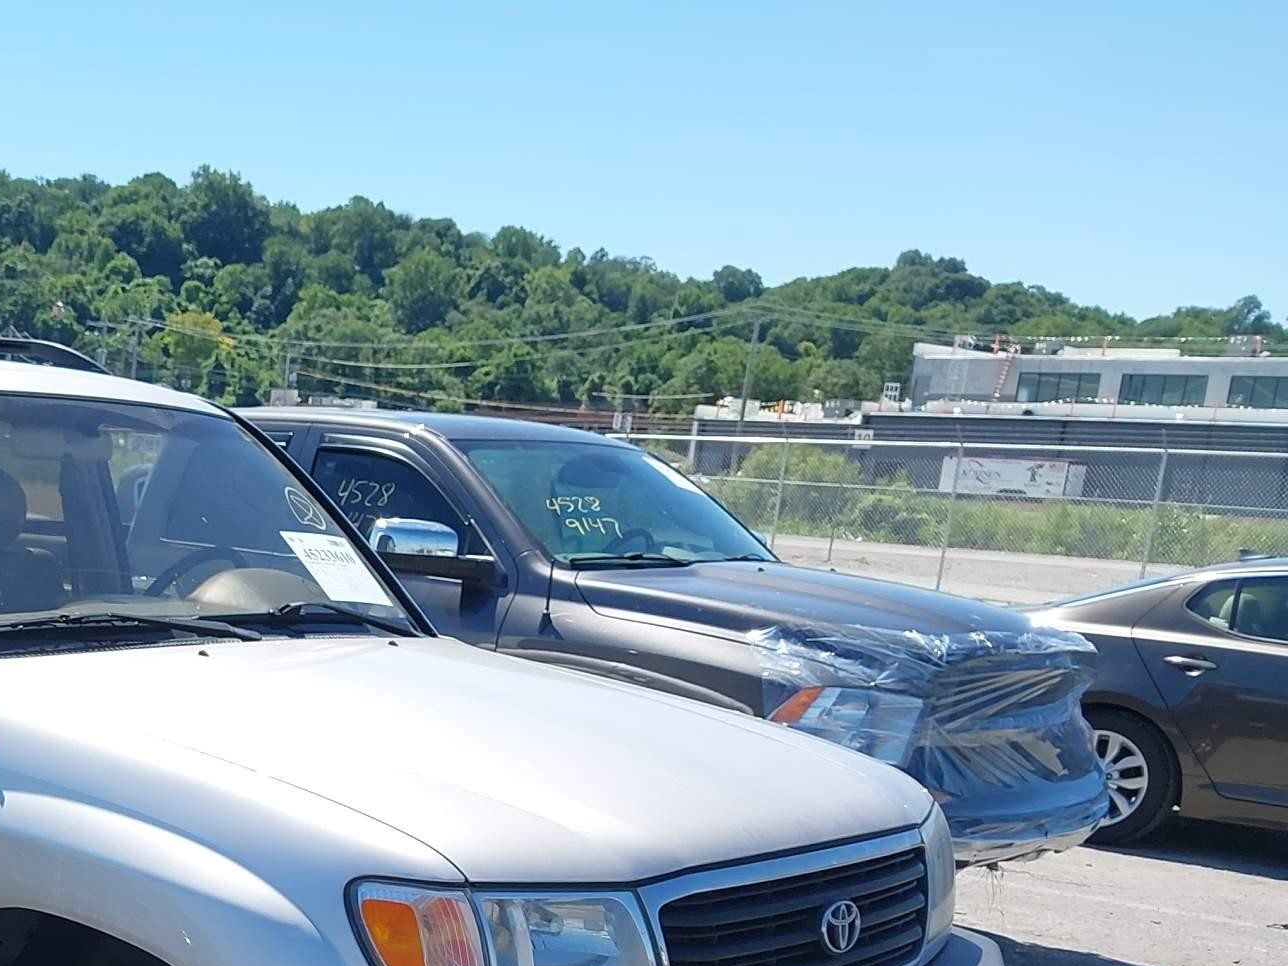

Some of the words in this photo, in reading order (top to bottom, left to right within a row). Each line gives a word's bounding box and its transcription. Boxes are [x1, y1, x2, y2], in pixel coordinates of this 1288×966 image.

[337, 478, 396, 507] 4528
[546, 496, 601, 515] 4528
[565, 517, 623, 539] 9147
[303, 548, 356, 565] 45233610
